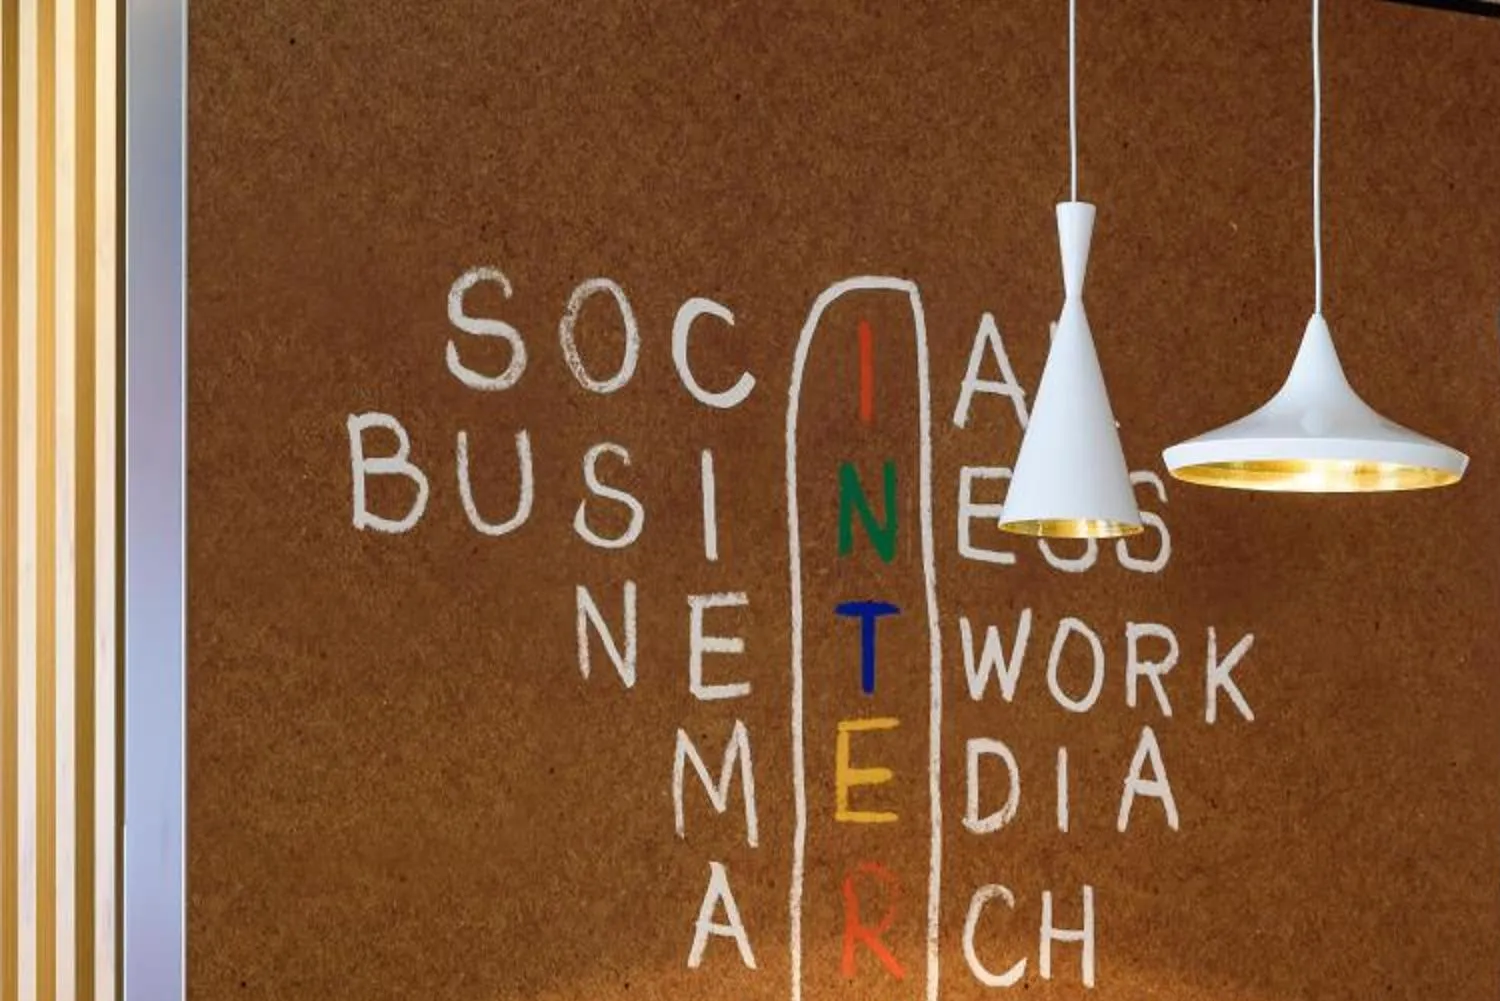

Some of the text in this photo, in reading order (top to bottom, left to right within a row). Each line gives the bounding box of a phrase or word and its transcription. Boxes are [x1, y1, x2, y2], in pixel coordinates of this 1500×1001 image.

[445, 265, 1121, 429] SOCIA
[347, 412, 1171, 573] BUSINES
[577, 581, 1255, 725] NETWORK
[672, 718, 1180, 848] MEDIA
